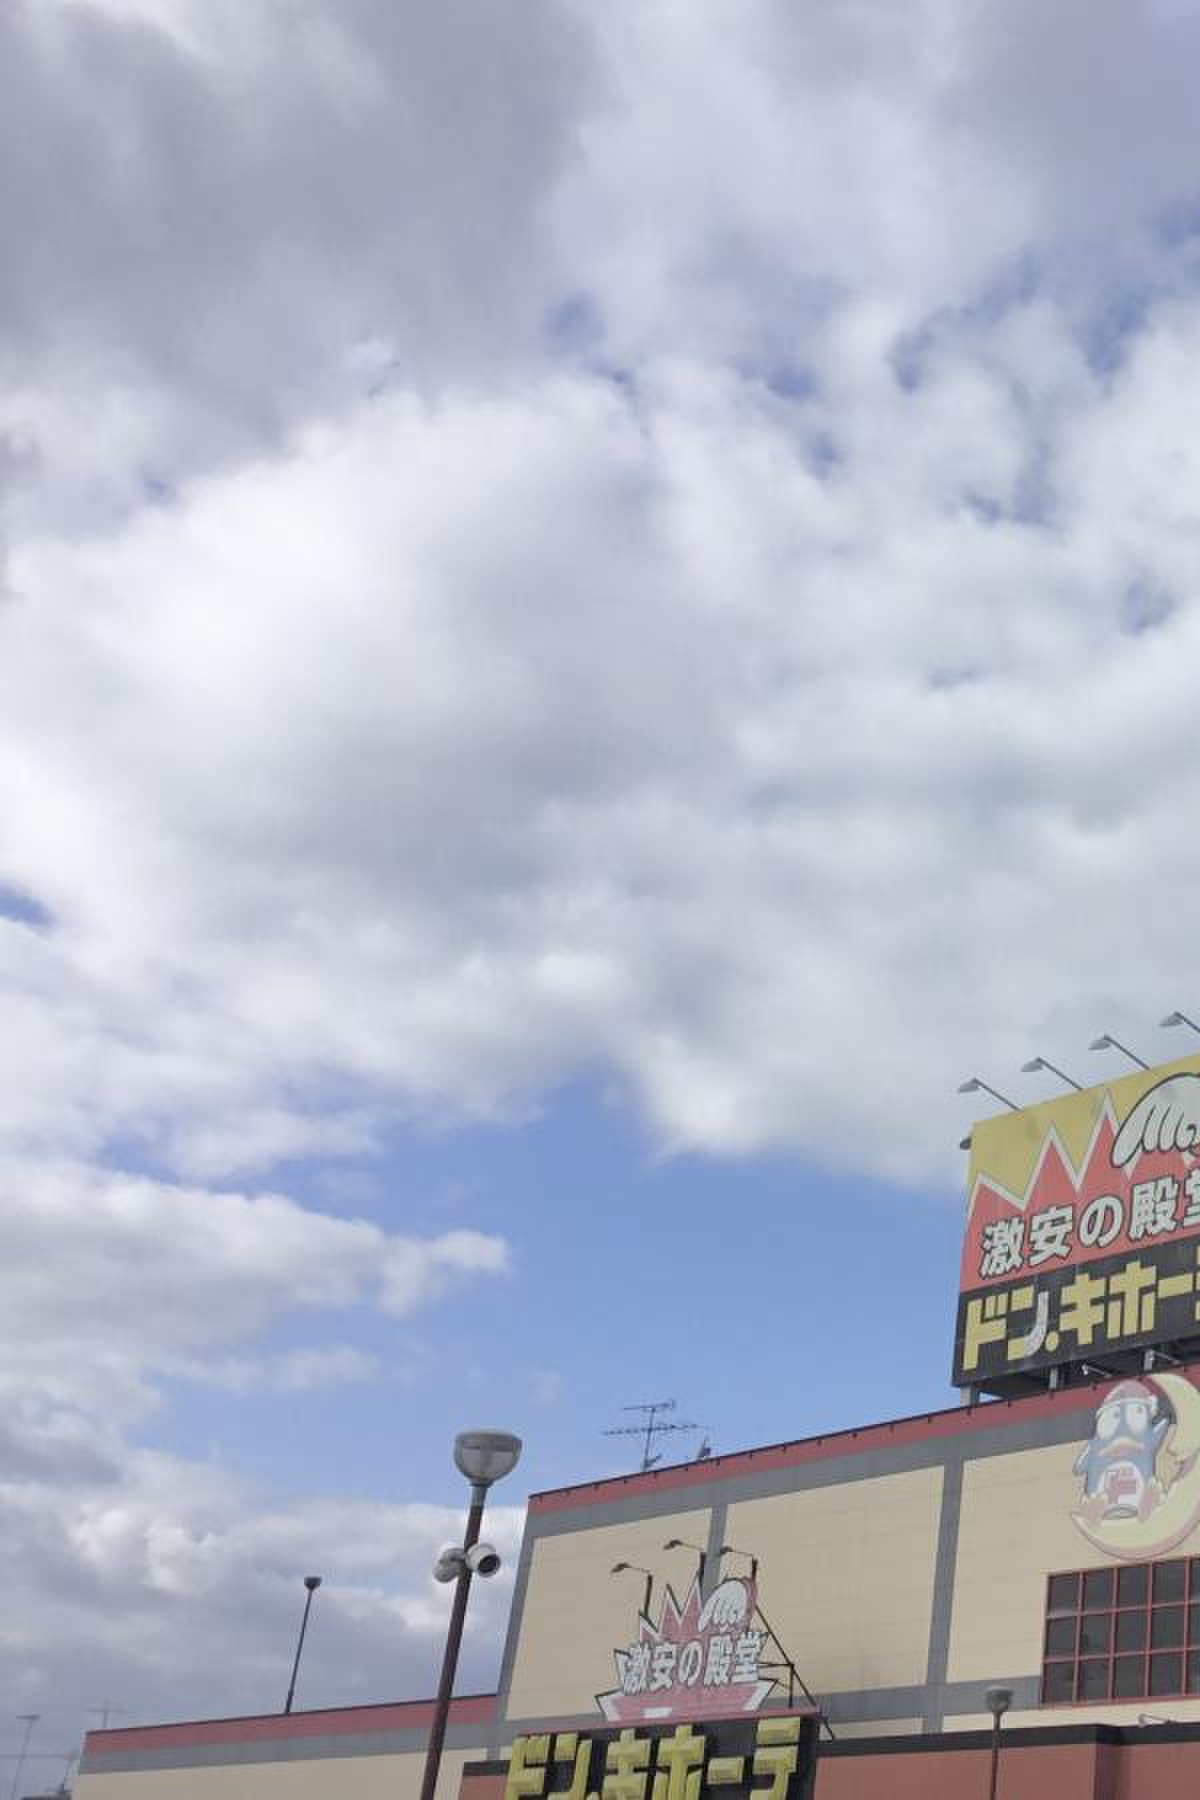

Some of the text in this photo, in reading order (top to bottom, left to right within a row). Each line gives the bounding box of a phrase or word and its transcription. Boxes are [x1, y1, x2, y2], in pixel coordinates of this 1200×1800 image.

[620, 1630, 769, 1695] 激安の殿堂
